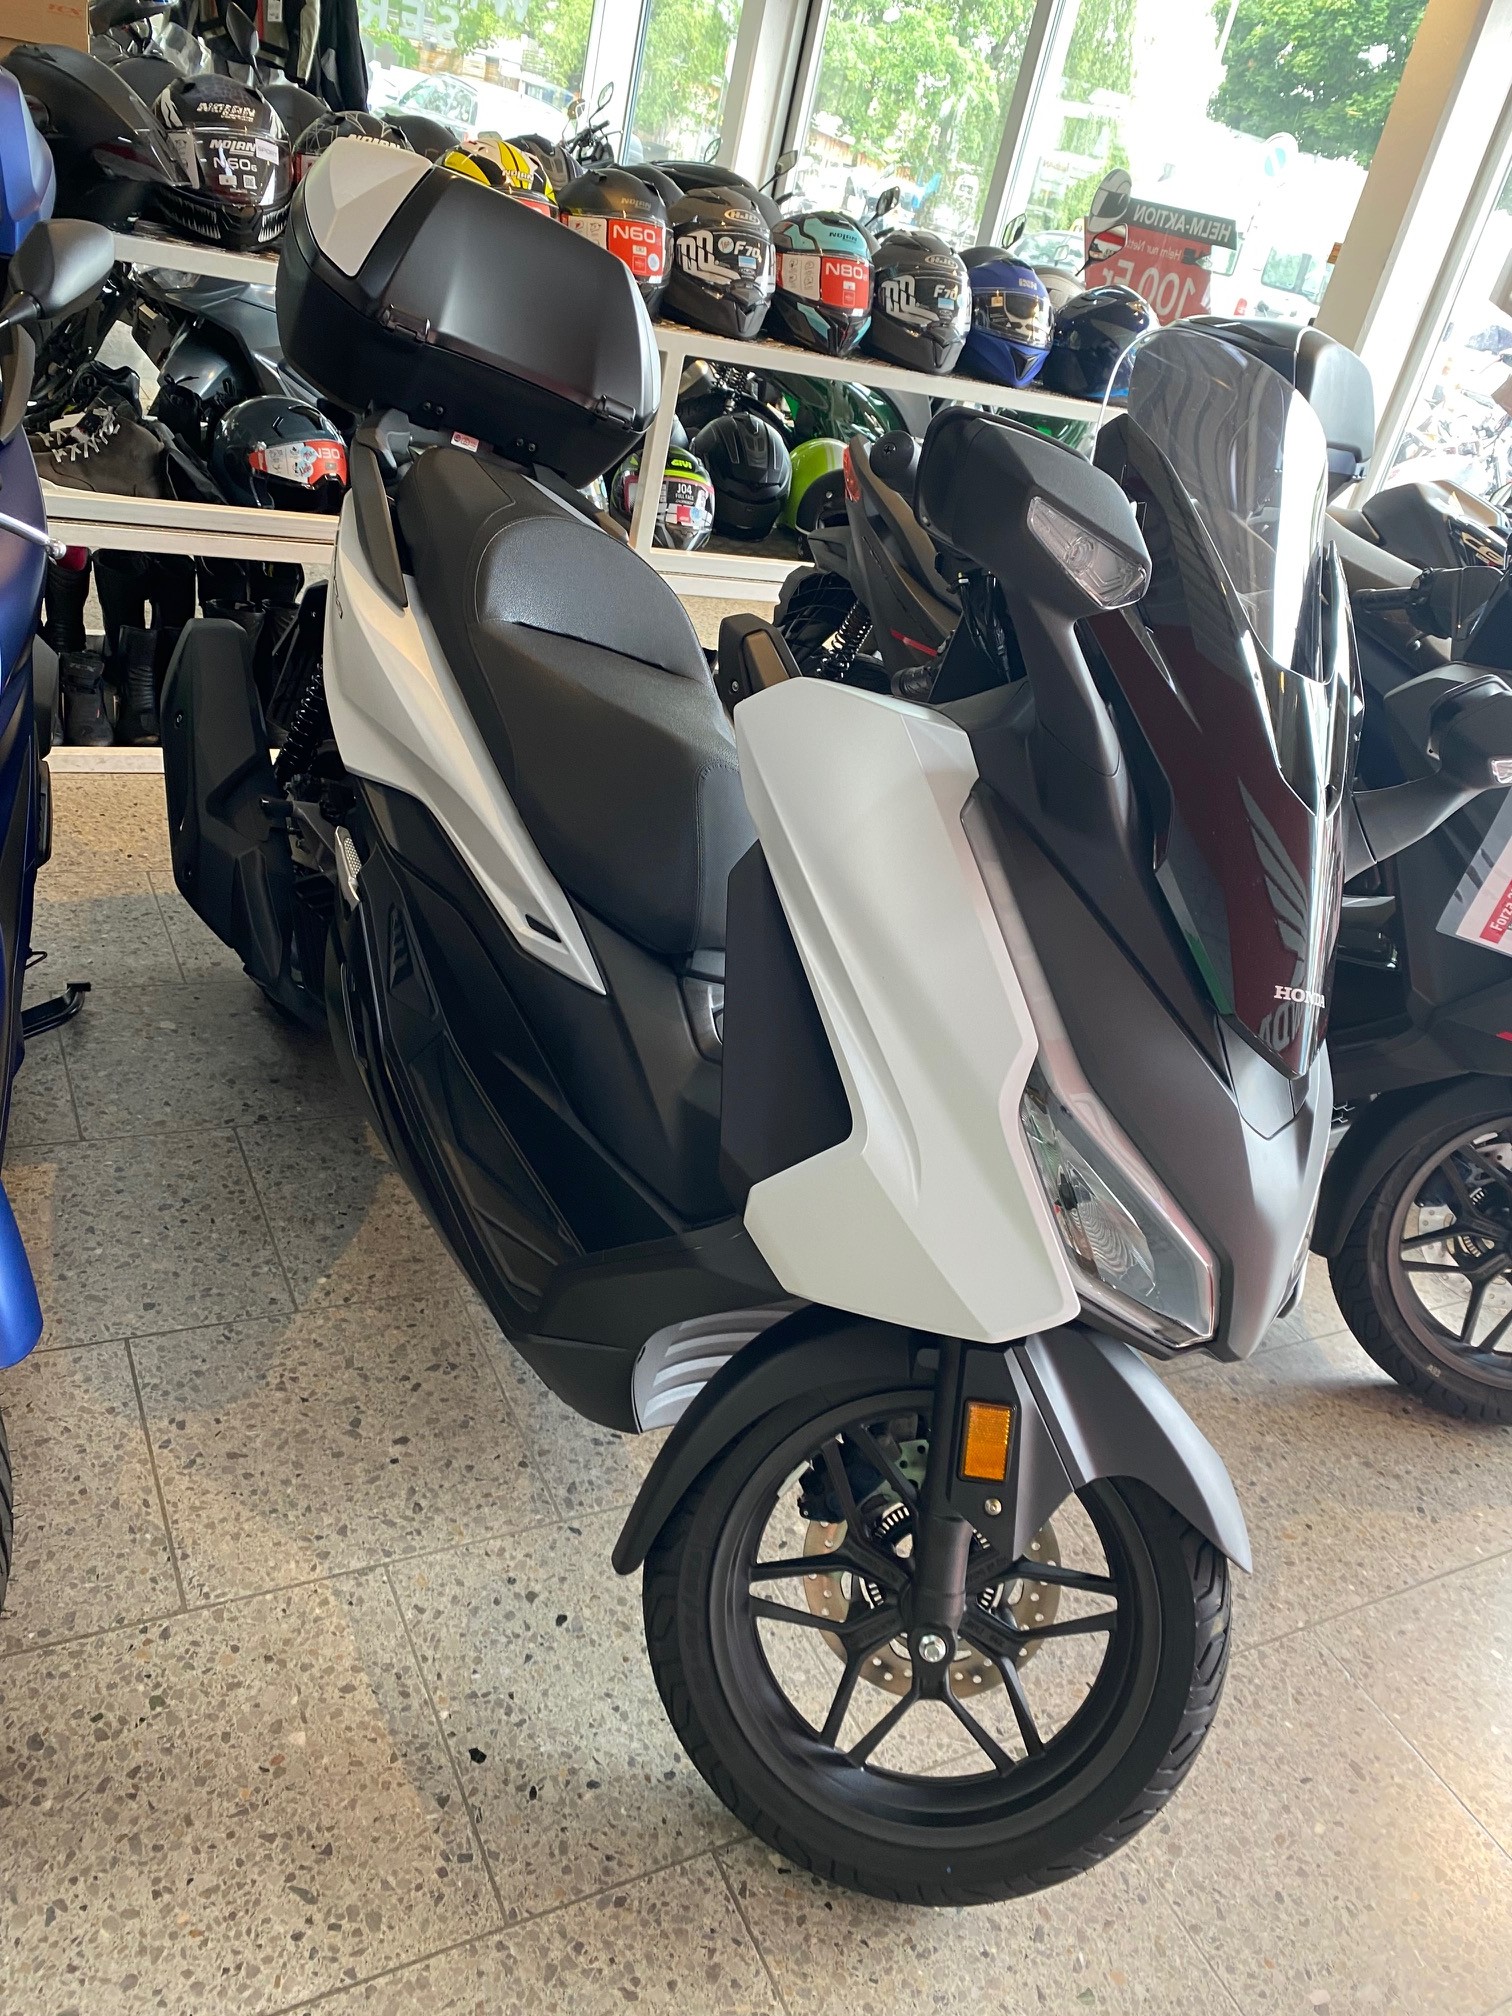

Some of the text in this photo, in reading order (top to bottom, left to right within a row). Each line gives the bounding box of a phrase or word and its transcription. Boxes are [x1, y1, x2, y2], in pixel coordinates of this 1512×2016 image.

[209, 139, 256, 156] NOLAN
[671, 459, 692, 469] GIVI
[677, 483, 692, 495] J04
[1274, 985, 1325, 1008] HONDA
